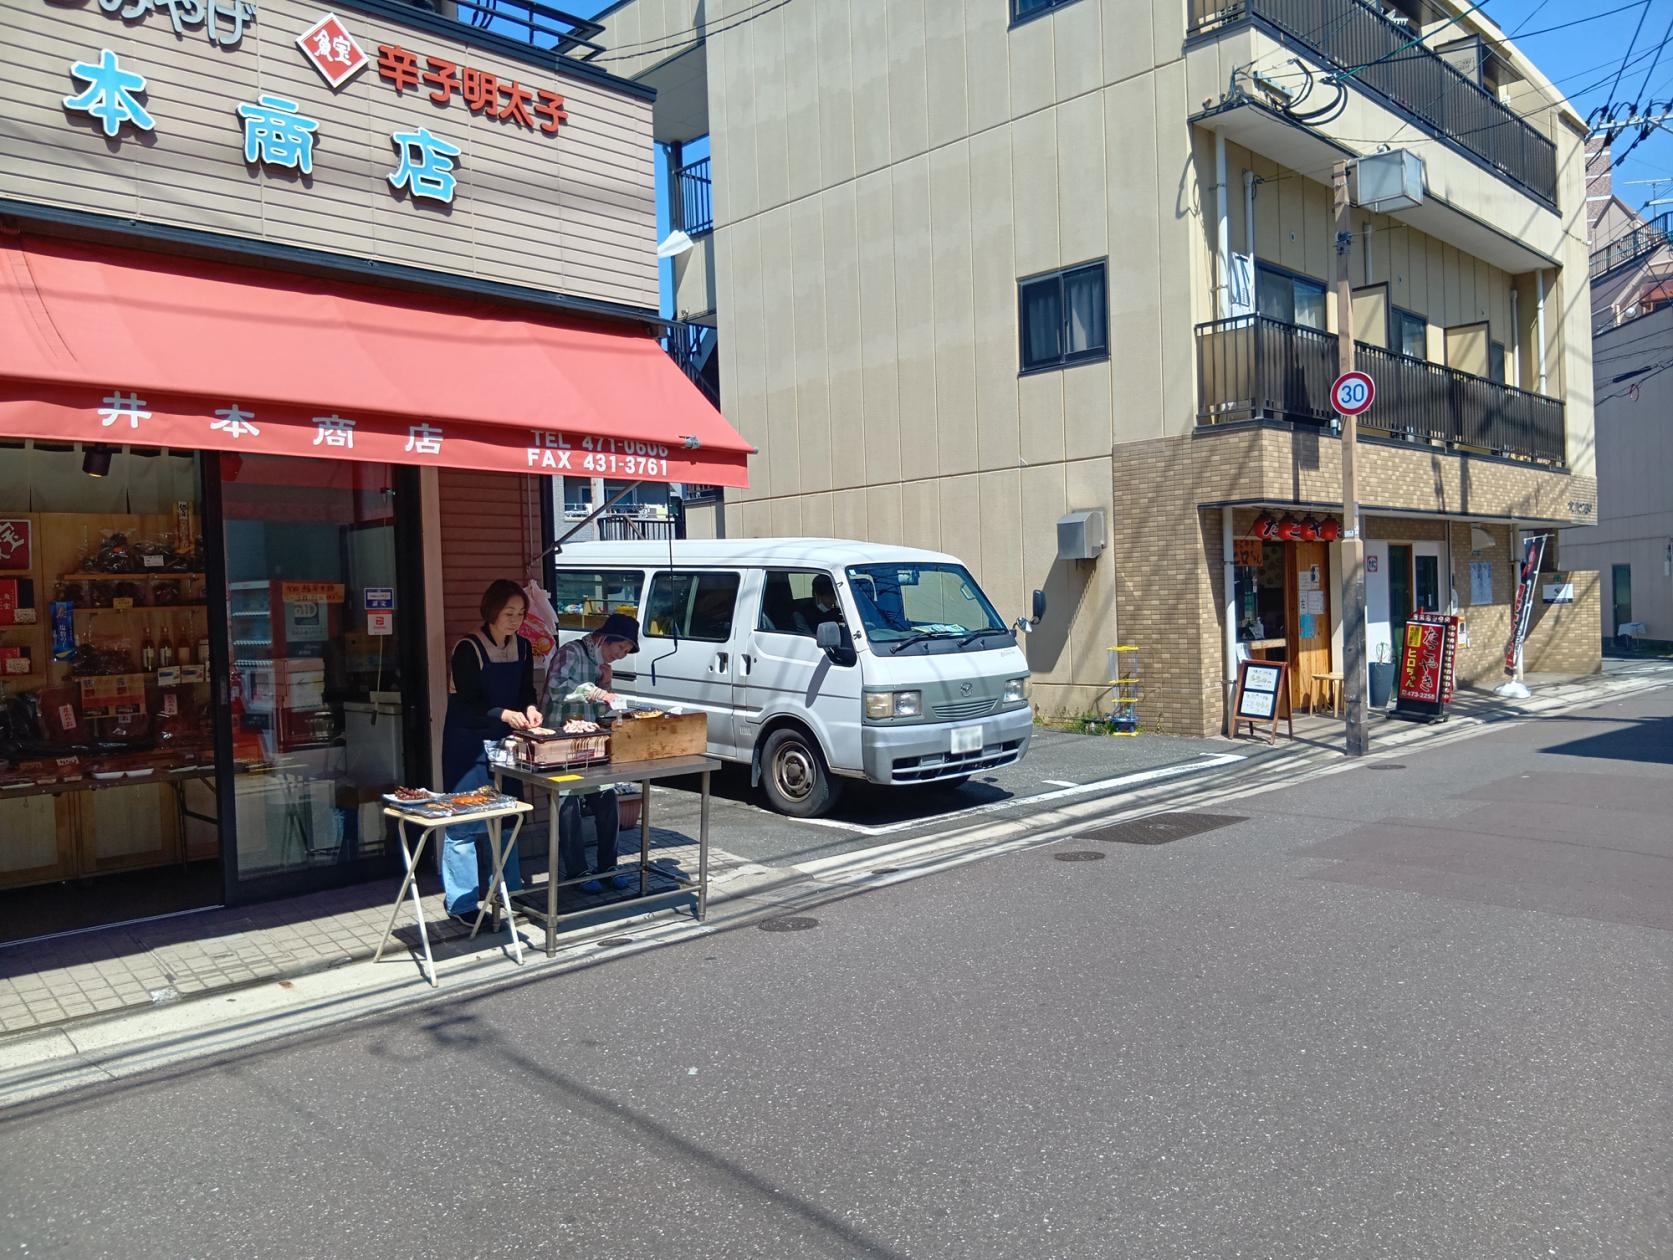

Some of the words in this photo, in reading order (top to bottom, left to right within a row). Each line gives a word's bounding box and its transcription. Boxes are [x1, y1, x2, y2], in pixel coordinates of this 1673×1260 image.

[377, 44, 569, 133] 辛子明太子
[1341, 383, 1365, 404] 30
[97, 390, 444, 456] 井本商店
[530, 430, 571, 449] TEL
[527, 448, 572, 470] FAX
[583, 454, 668, 477] 431-3761
[1405, 648, 1417, 688] ヒロちゃん
